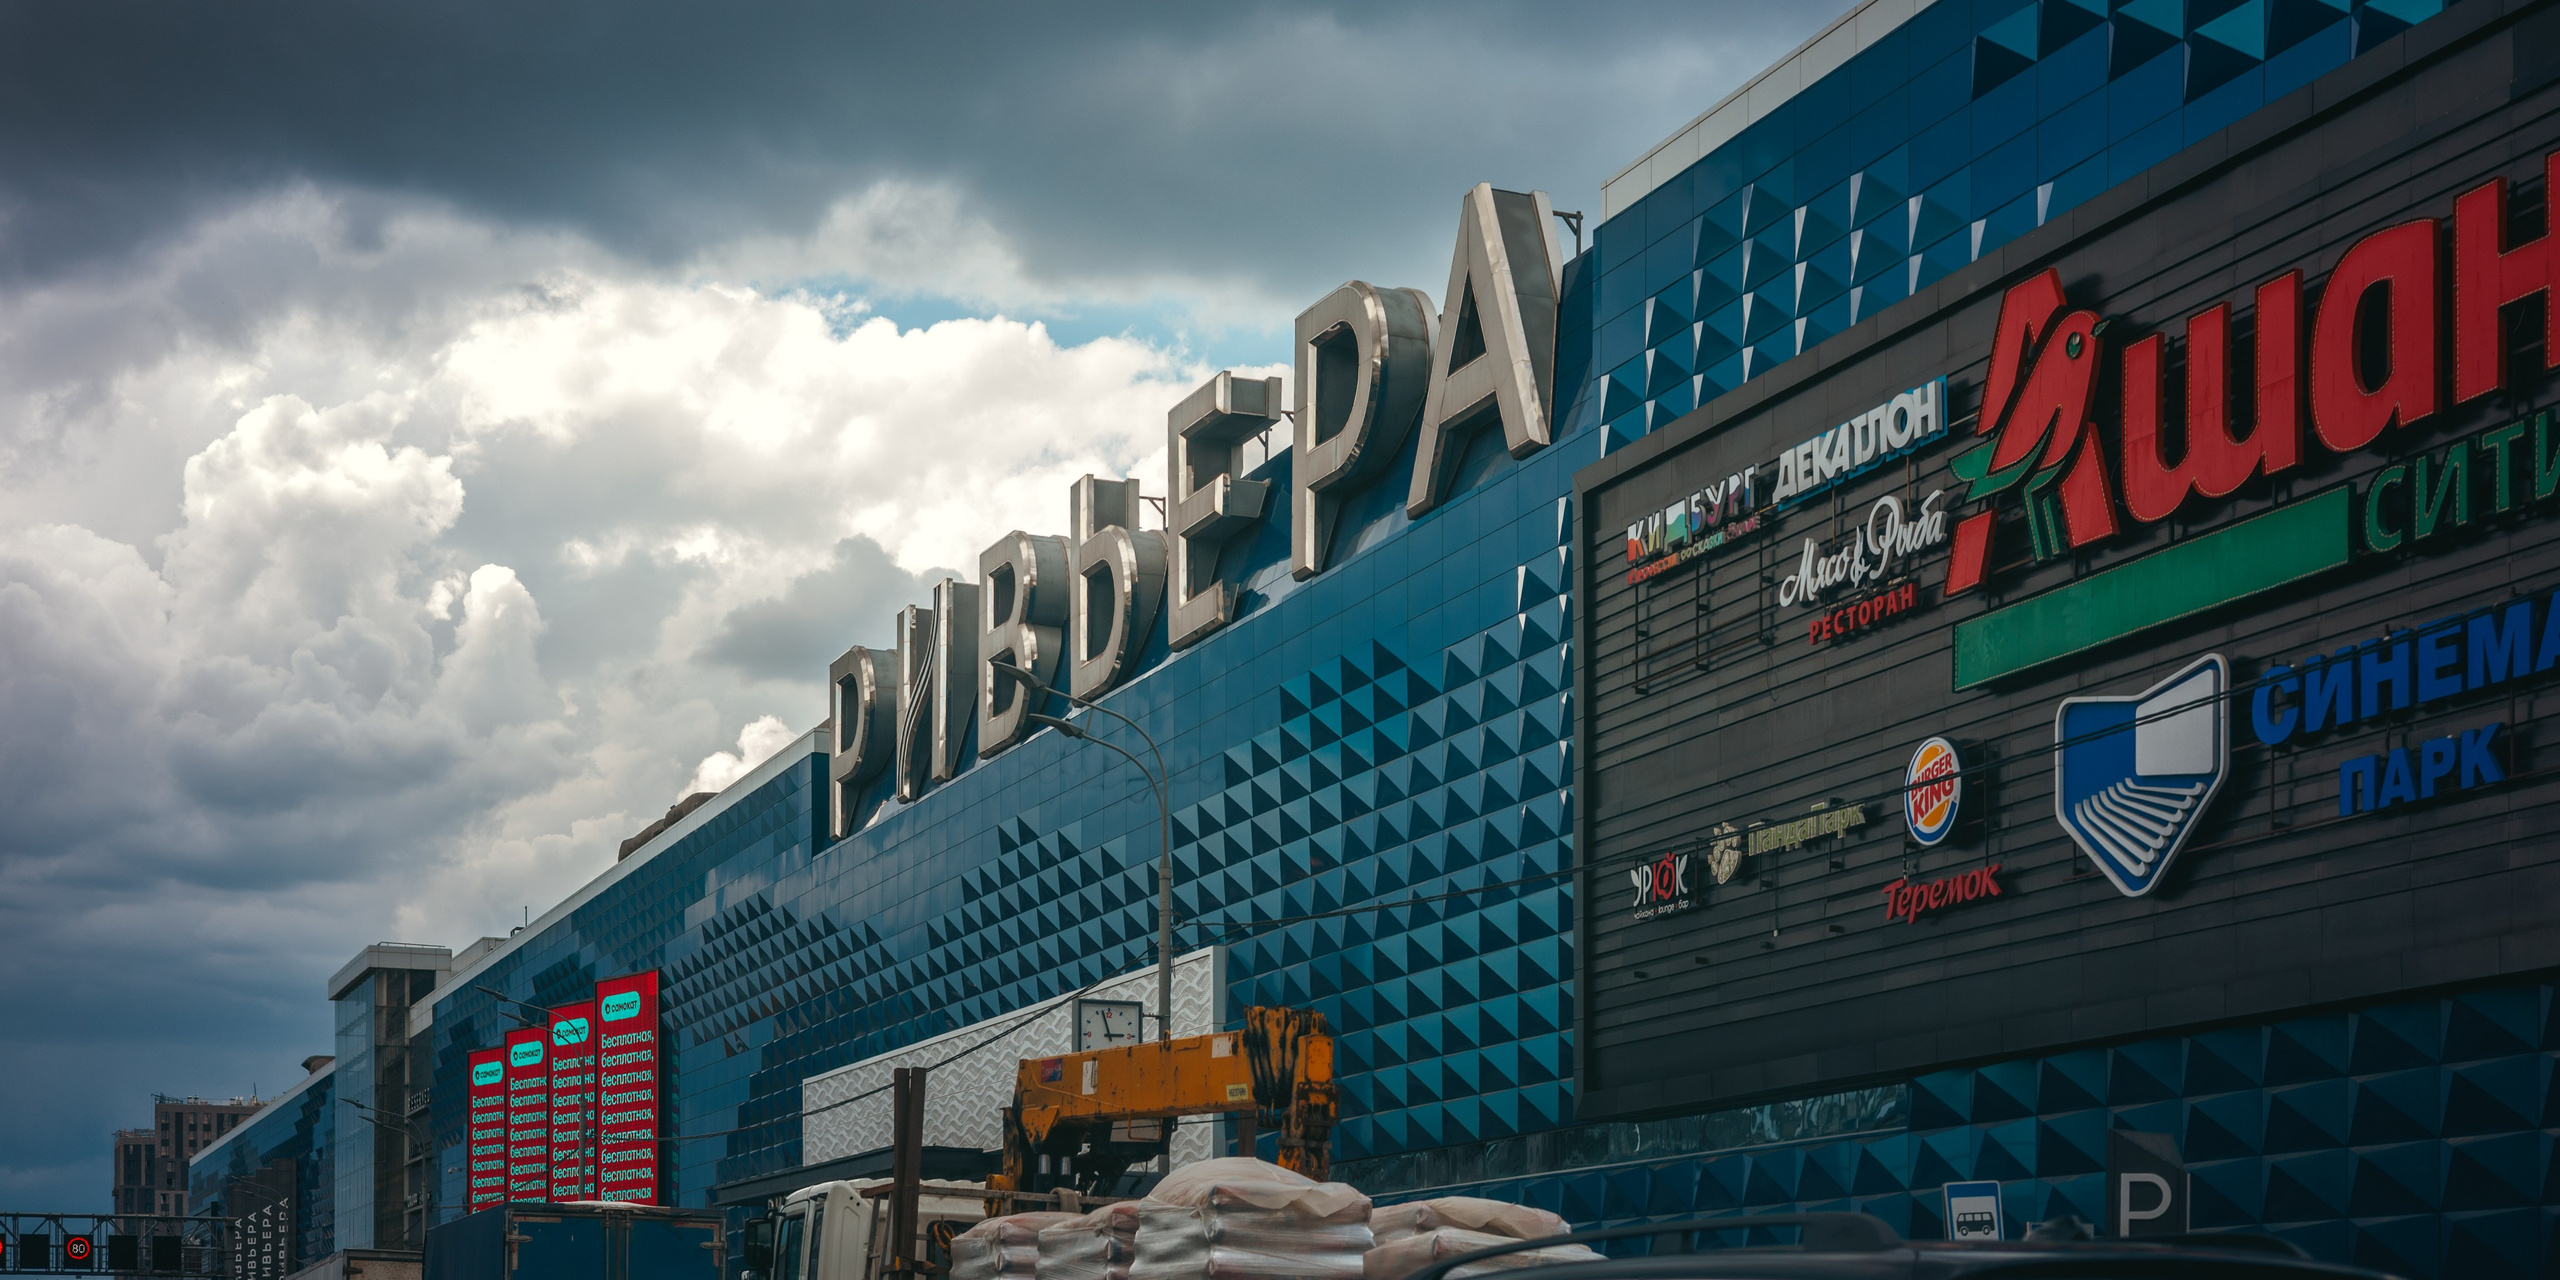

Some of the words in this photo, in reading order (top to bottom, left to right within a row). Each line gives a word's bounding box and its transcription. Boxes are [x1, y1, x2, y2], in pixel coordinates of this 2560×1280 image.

[1772, 380, 1944, 505] ДЕКАТЛОН
[829, 183, 1563, 841] РИВЬЕРА
[1627, 463, 1759, 564] КИДБУРГ
[1779, 537, 1849, 608] Мясо
[1867, 489, 1948, 581] Рыба
[1809, 582, 1918, 646] РЕСТОРАН
[1910, 752, 1953, 801] BURGER
[2339, 721, 2508, 818] ПАРК
[1913, 769, 1954, 827] KING
[1630, 852, 1689, 907] УРЮК
[1881, 863, 2003, 925] Теремок
[1678, 899, 1690, 910] бар
[611, 1000, 638, 1013] самокат
[601, 1030, 654, 1049] Бесплатная,
[601, 1049, 654, 1068] бесплатная,
[601, 1070, 654, 1087] бесплатная,
[601, 1089, 654, 1106] бесплатная,
[601, 1108, 654, 1125] бесплатная,
[601, 1148, 654, 1164] бесплатная,
[601, 1167, 654, 1183] бесплатная,
[601, 1187, 651, 1202] бесплатная
[2119, 1172, 2173, 1238] P
[72, 1243, 86, 1254] 80
